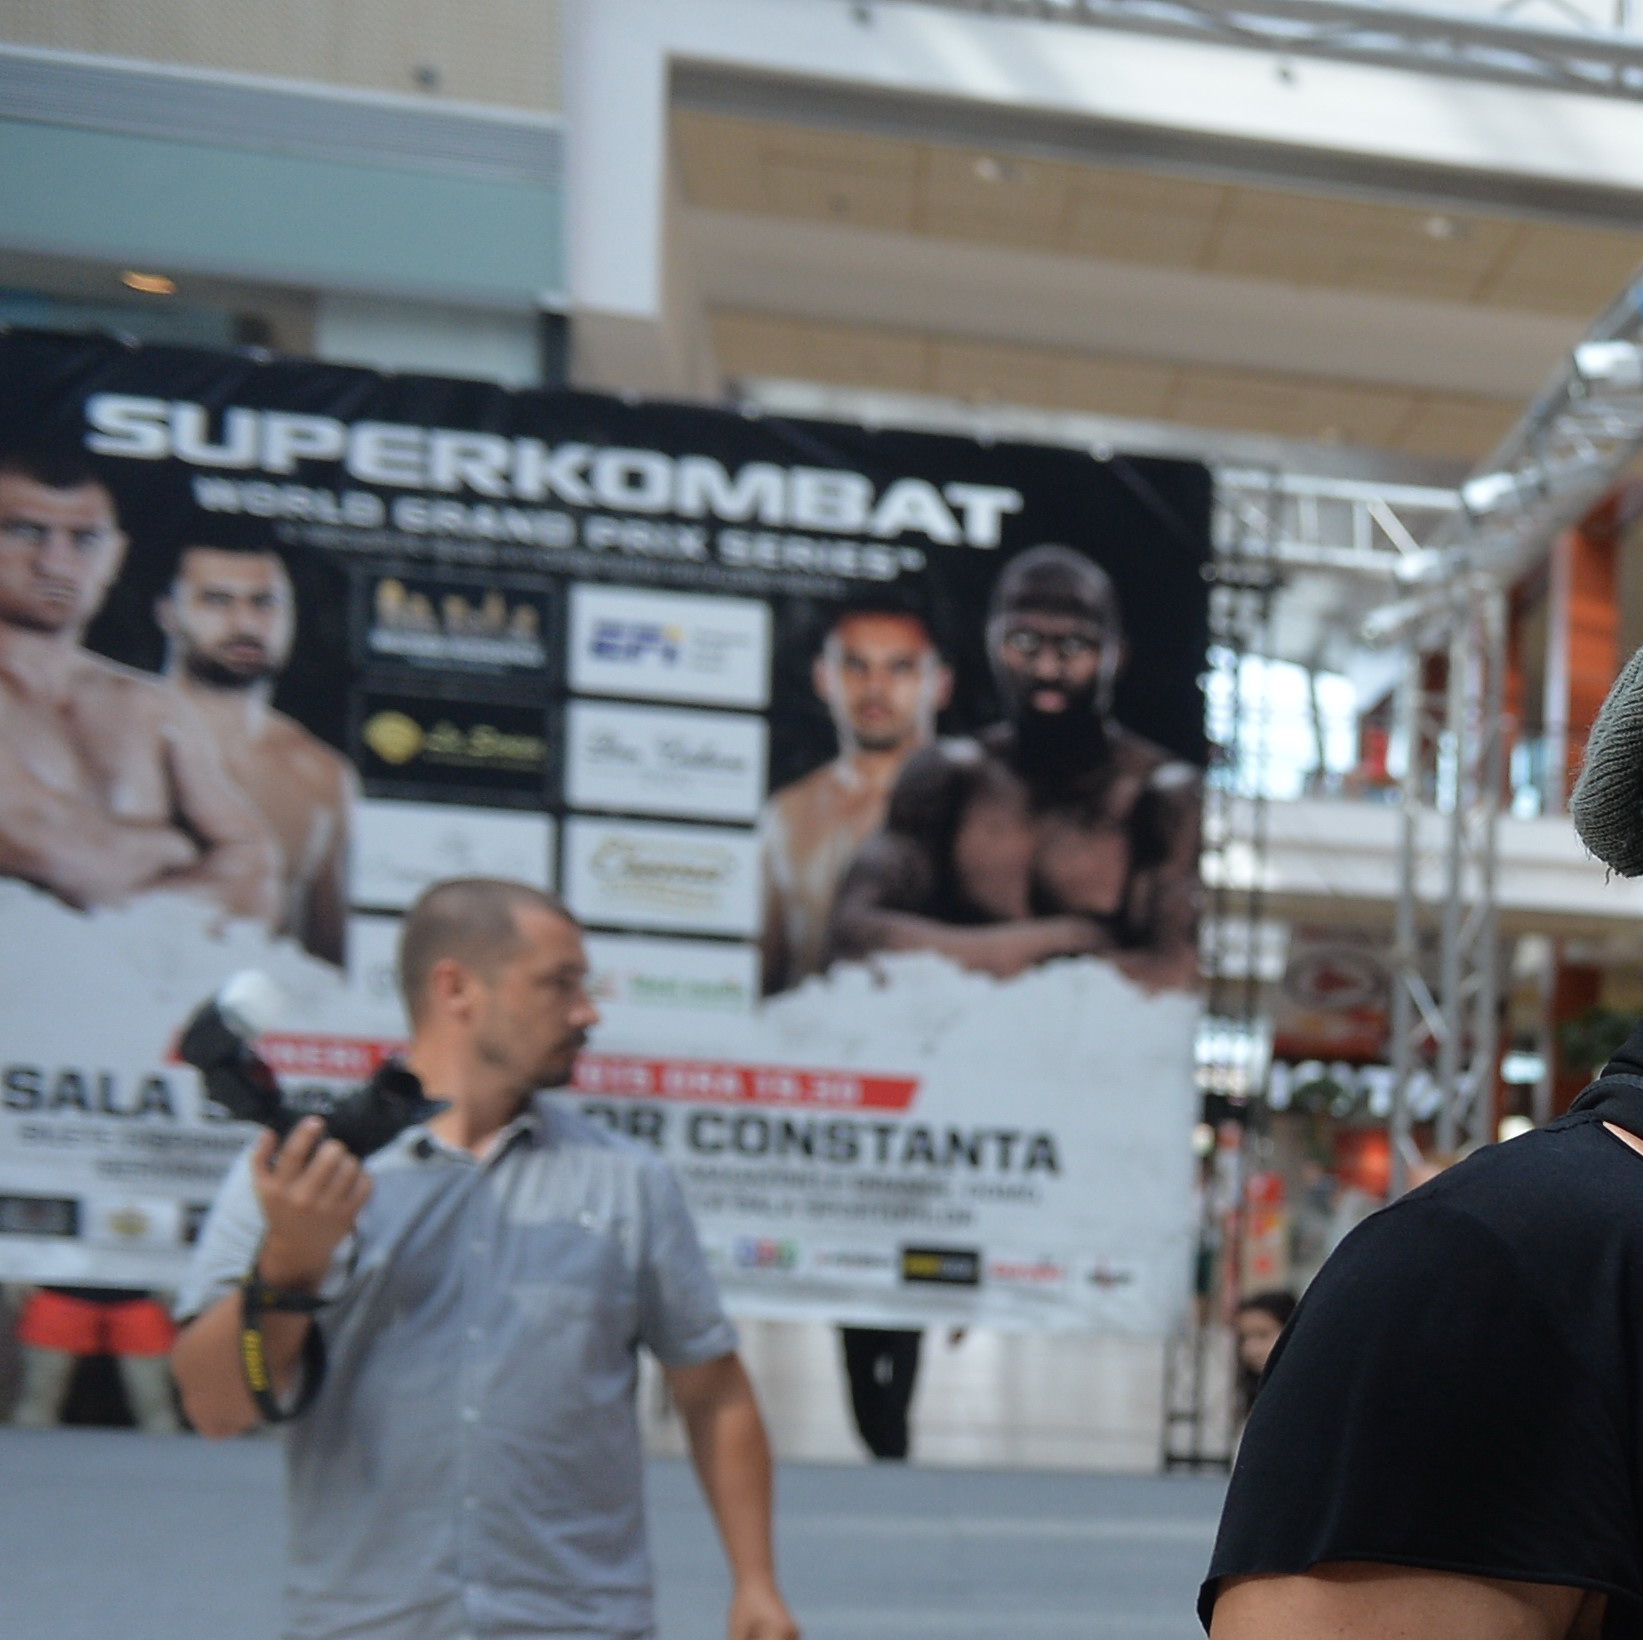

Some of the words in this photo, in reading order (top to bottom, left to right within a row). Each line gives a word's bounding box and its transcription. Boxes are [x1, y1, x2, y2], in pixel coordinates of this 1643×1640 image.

[85, 392, 1026, 551] SUPERKOMBAT
[192, 474, 386, 530] WORLD
[392, 495, 579, 550] GRAND
[582, 513, 709, 564] PRIX
[1, 1066, 177, 1119] SALA
[685, 1107, 1062, 1178] CONSTANTA
